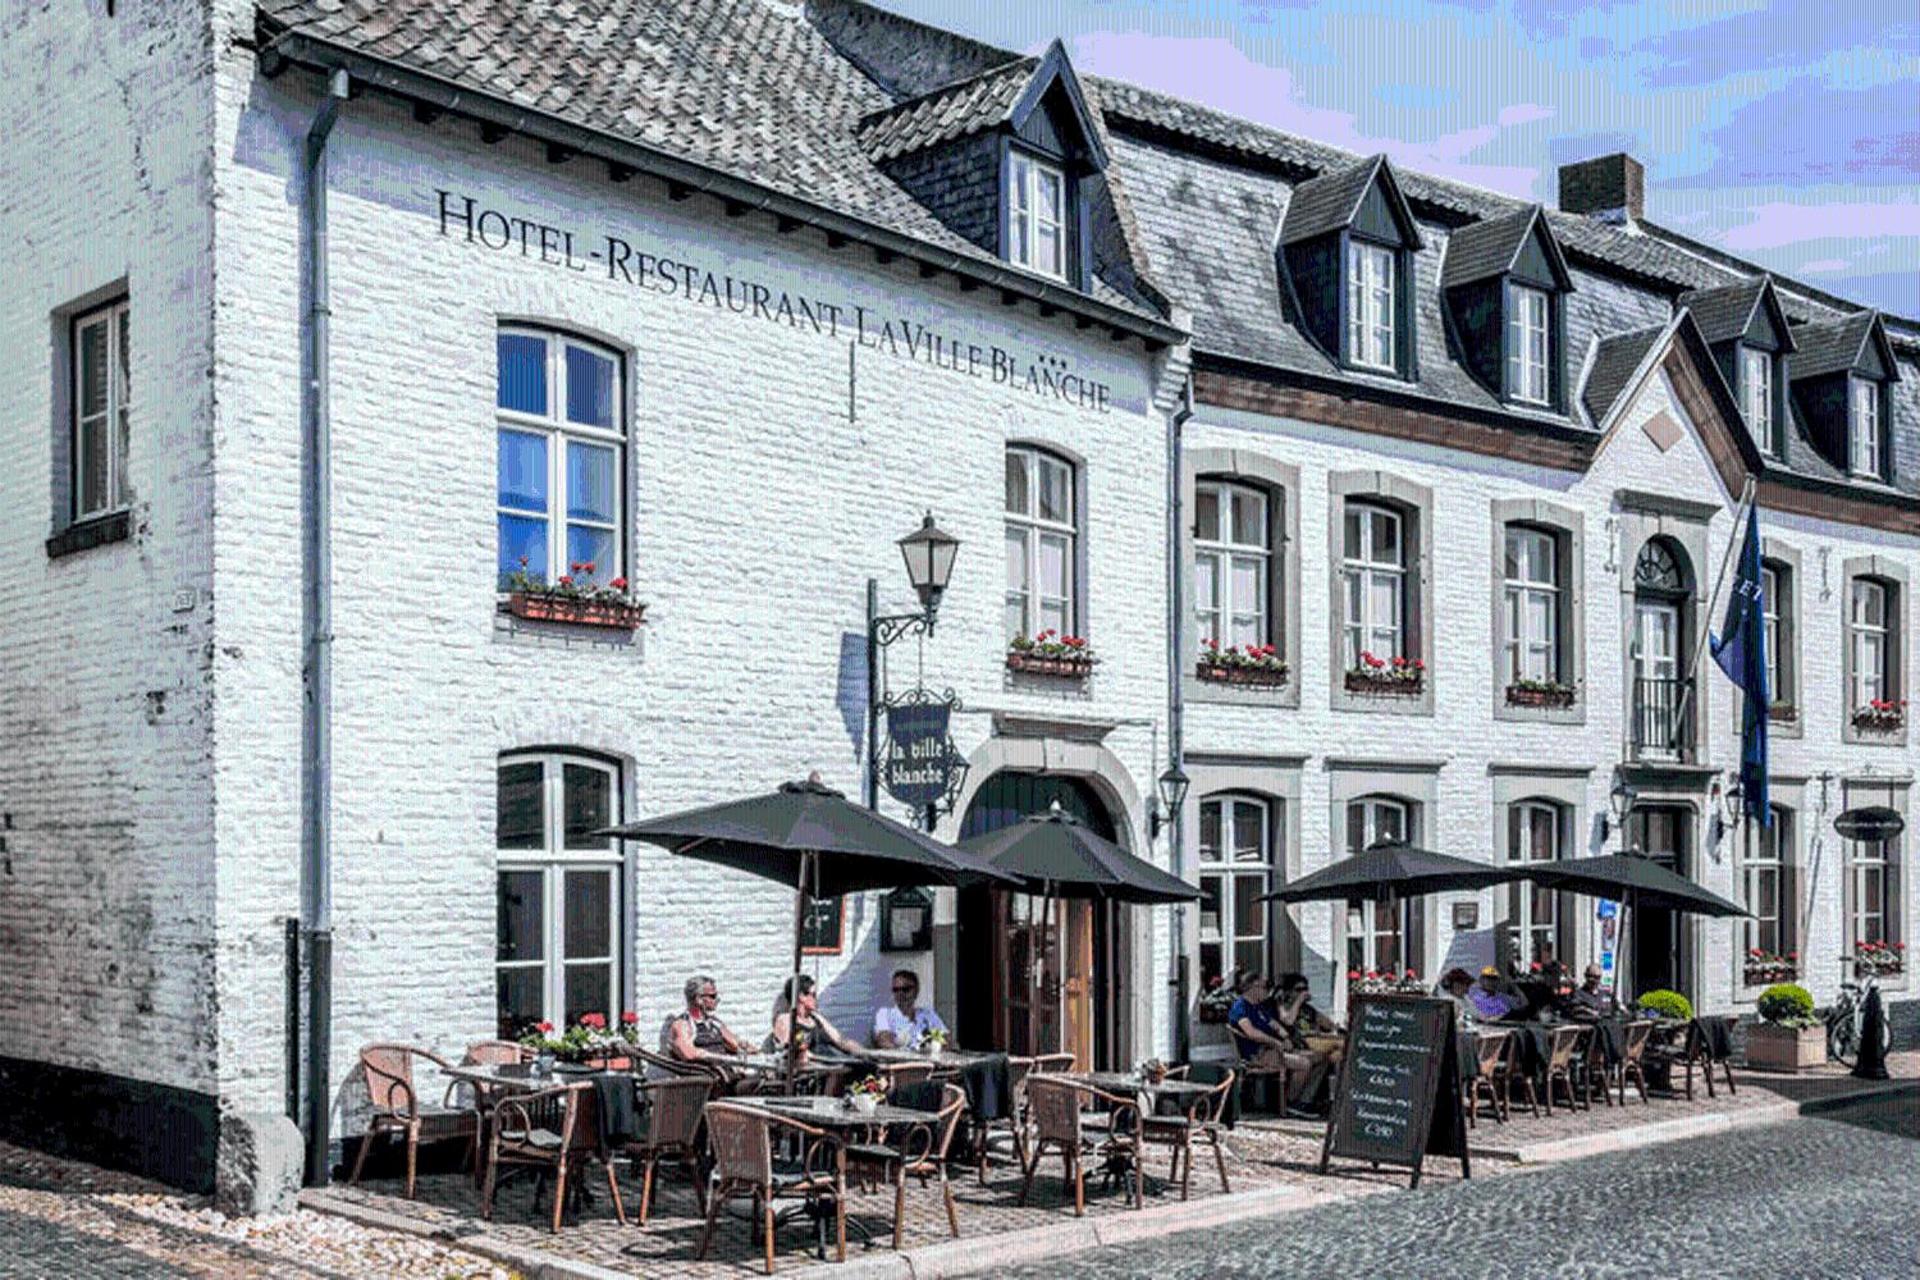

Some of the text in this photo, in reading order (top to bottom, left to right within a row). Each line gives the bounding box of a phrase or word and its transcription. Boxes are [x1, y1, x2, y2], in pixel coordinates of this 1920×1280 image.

[990, 345, 1111, 414] BLANCHE
[892, 736, 943, 760] la ville
[892, 761, 944, 785] blanche
